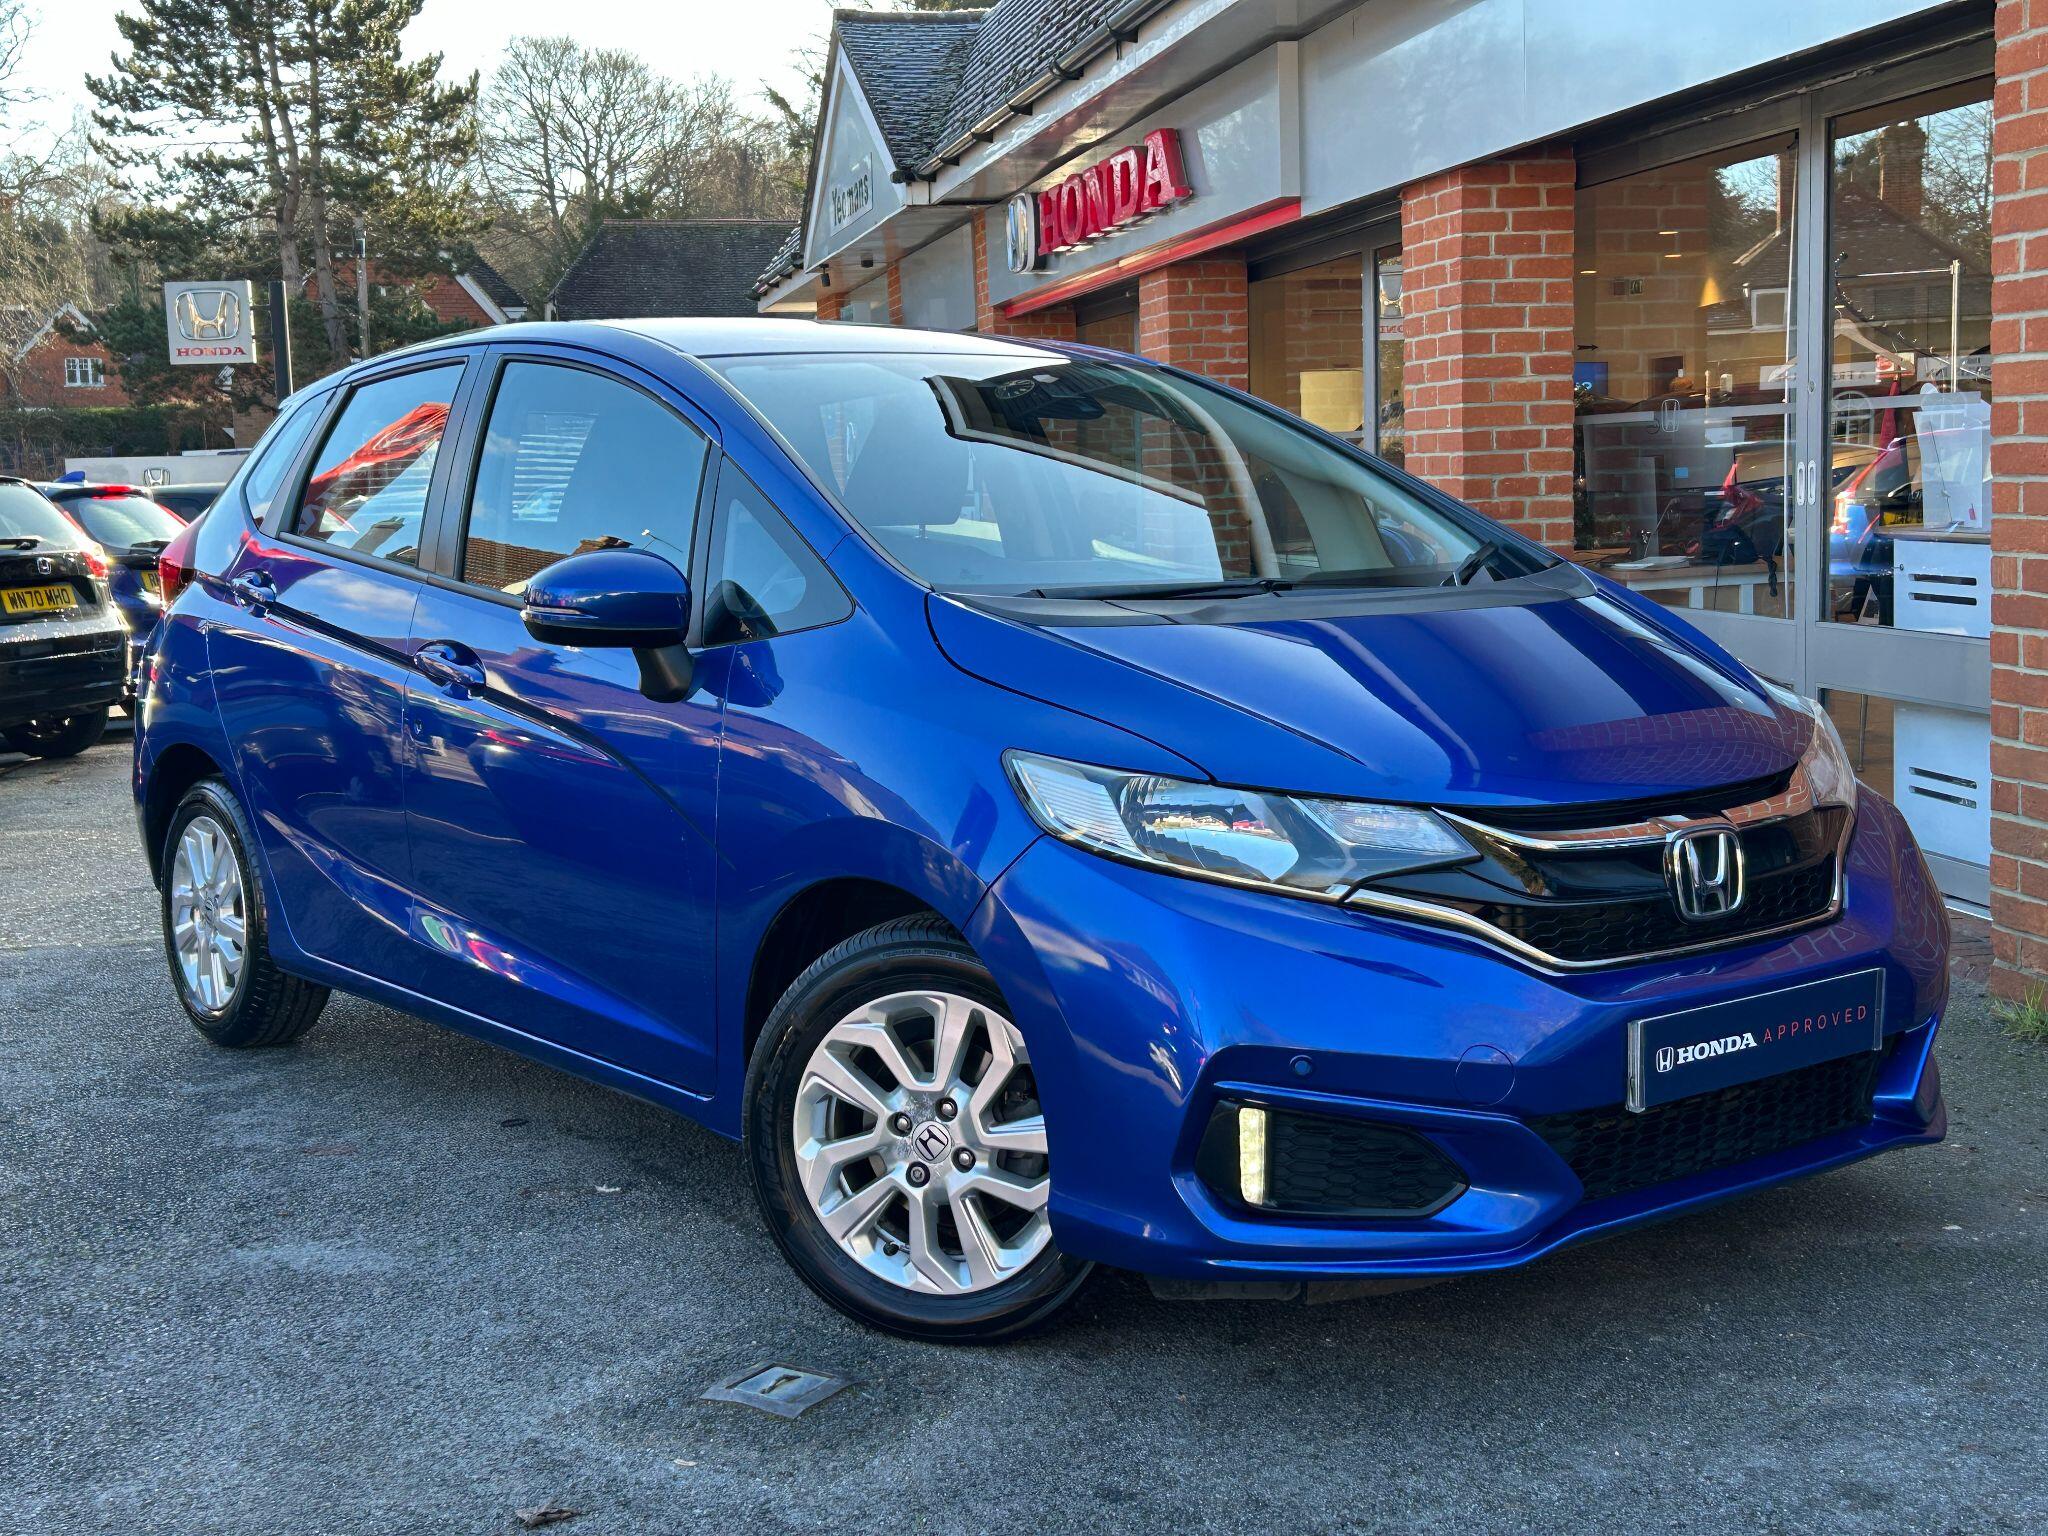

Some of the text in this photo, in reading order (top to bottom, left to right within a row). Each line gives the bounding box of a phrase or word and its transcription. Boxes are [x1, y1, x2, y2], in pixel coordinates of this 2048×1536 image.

[832, 174, 869, 226] Yeomans
[1037, 128, 1193, 257] HONDA
[176, 346, 247, 357] HONDA
[8, 588, 71, 610] WN70 MHO
[1676, 1005, 1867, 1065] HONDA APPROVED
